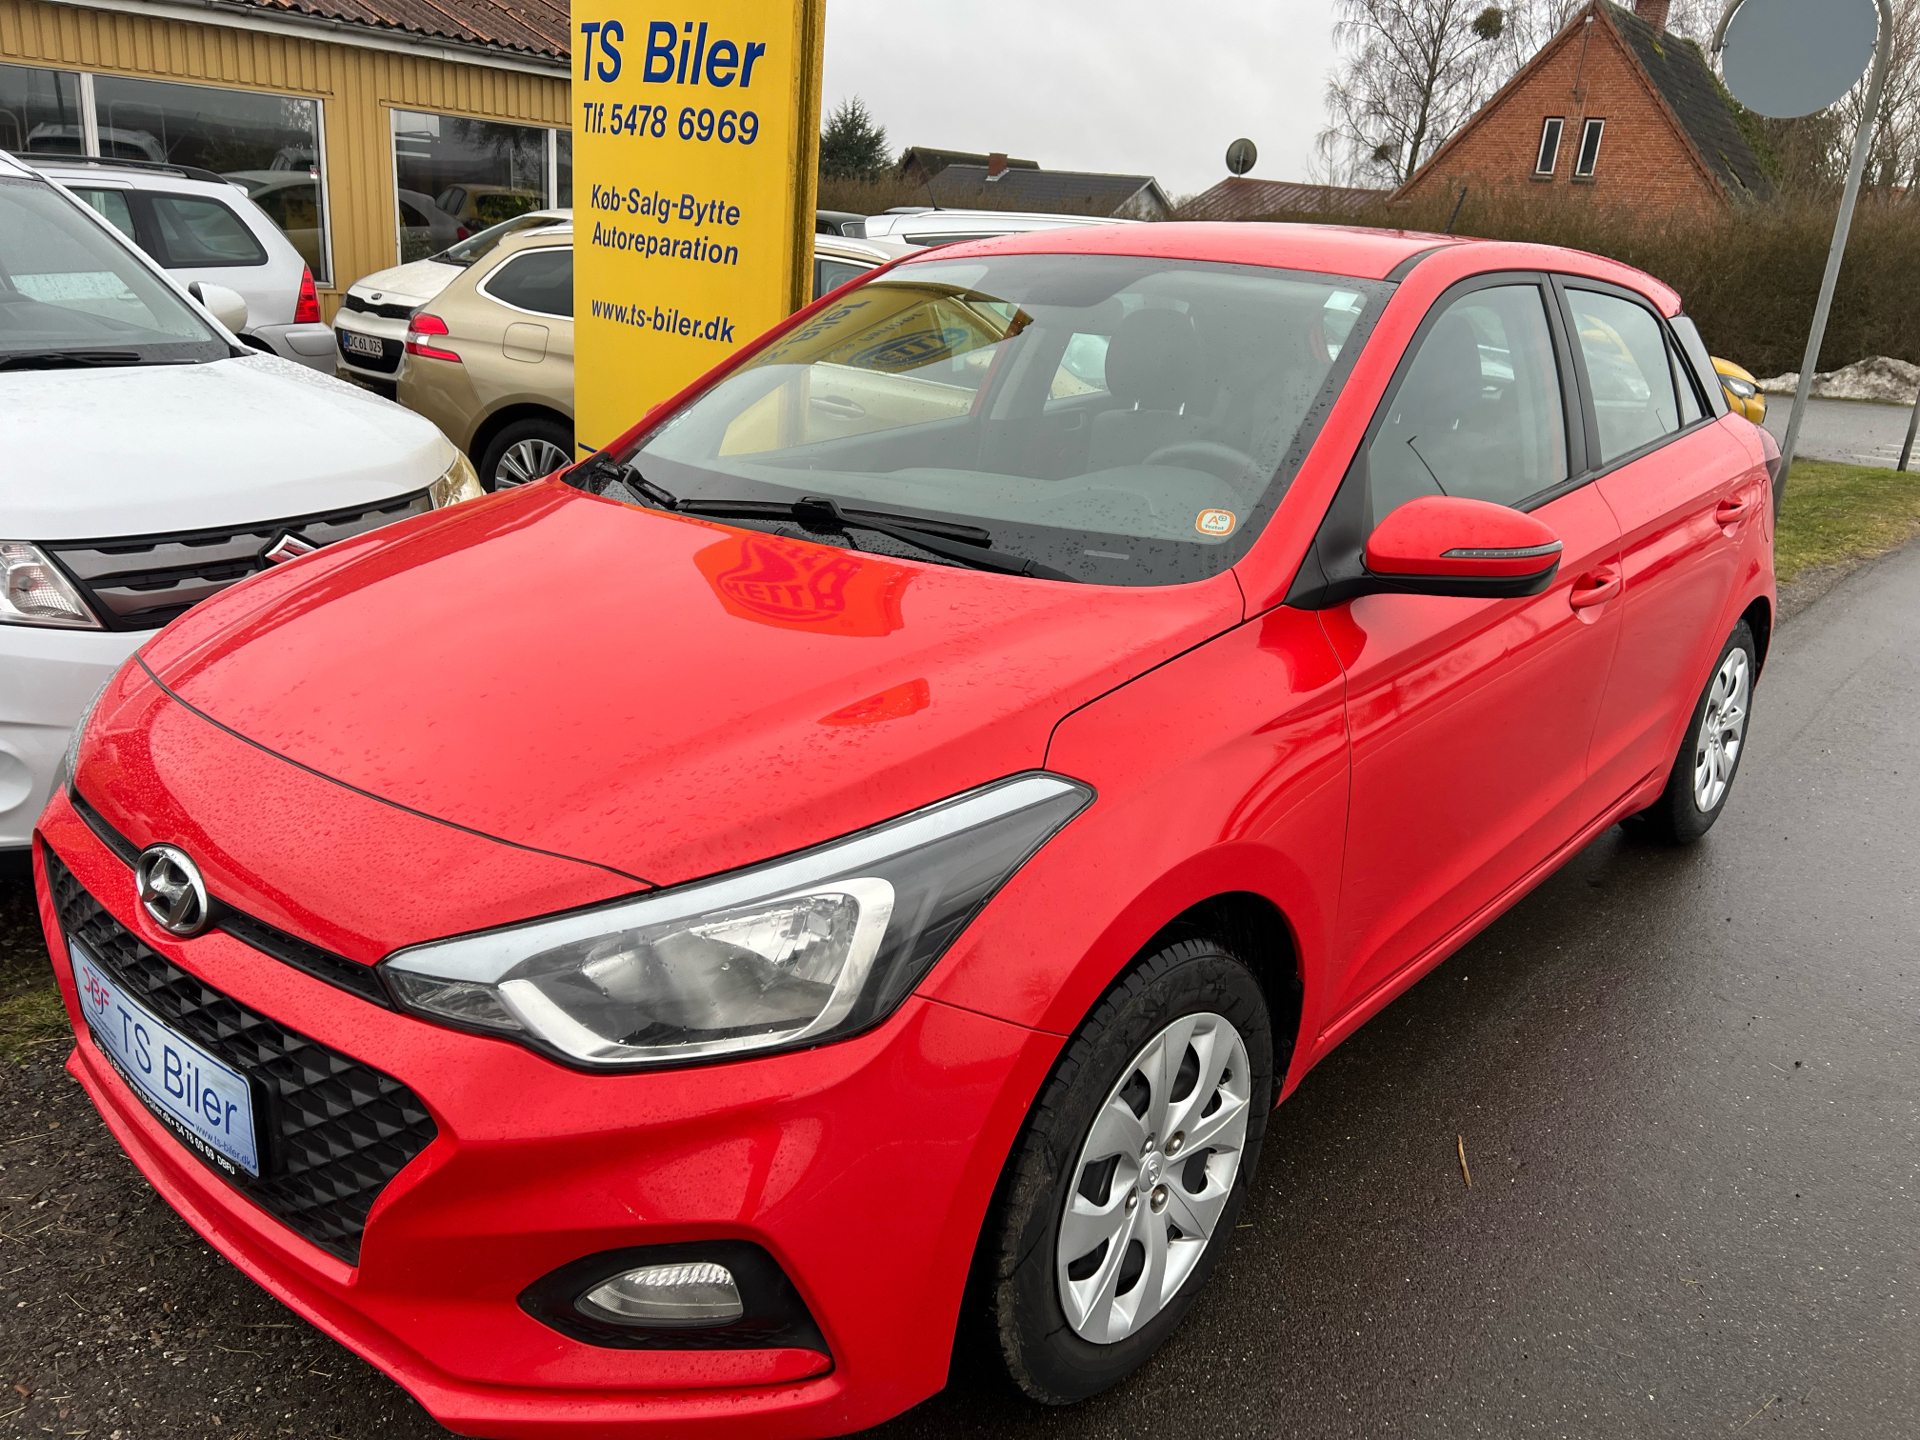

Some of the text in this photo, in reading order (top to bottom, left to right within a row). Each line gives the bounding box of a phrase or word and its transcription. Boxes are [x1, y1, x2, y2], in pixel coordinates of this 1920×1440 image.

[581, 20, 766, 88] TS Biler
[678, 107, 759, 145] 6969
[591, 183, 741, 227] Køb-Salg-Bytte
[592, 221, 739, 266] Autoreparation
[591, 299, 736, 344] www.ts-biler.dk
[359, 337, 367, 351] 61
[368, 340, 382, 353] 025
[117, 1004, 151, 1075] TS
[163, 1044, 237, 1135] Biler
